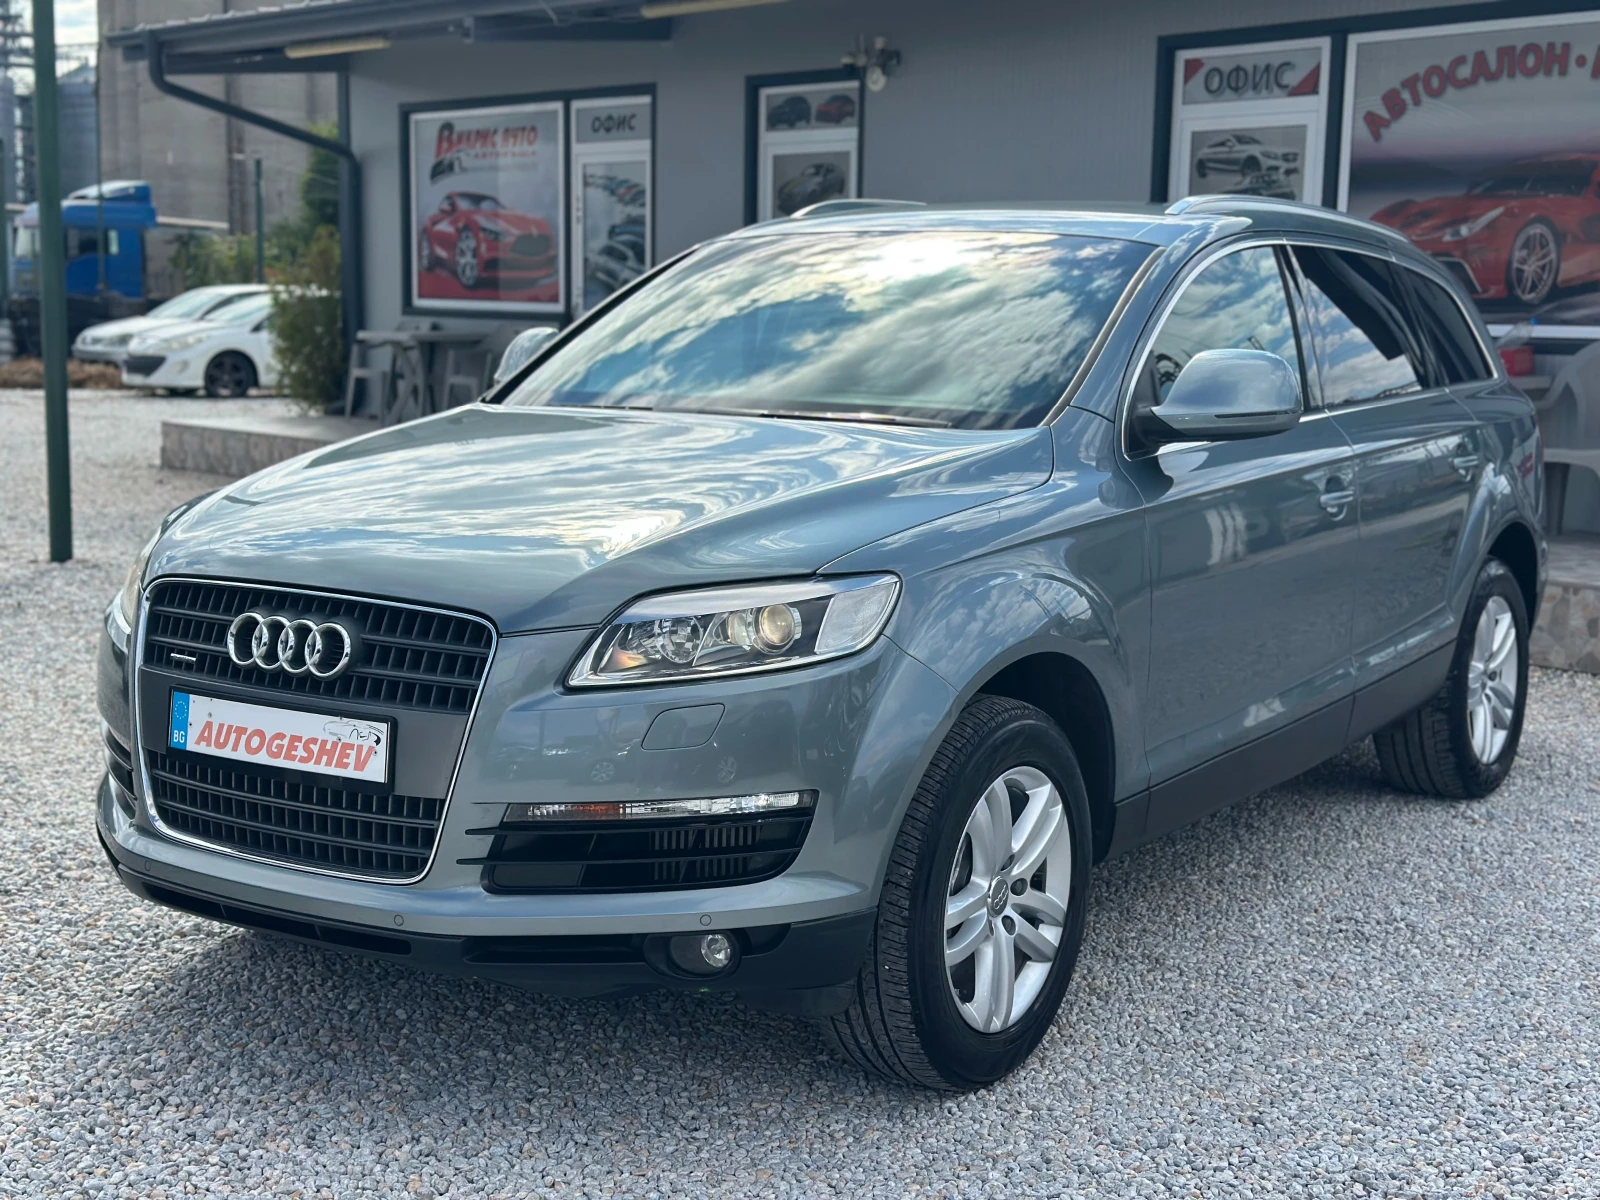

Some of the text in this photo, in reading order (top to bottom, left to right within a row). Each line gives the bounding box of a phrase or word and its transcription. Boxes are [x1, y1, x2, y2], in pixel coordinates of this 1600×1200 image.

[1204, 61, 1294, 95] ОФИС
[1363, 42, 1570, 141] АВТОСАЛОН
[591, 113, 637, 134] ОФИС
[173, 730, 185, 743] BG
[194, 720, 376, 772] AUTOGESHEV
